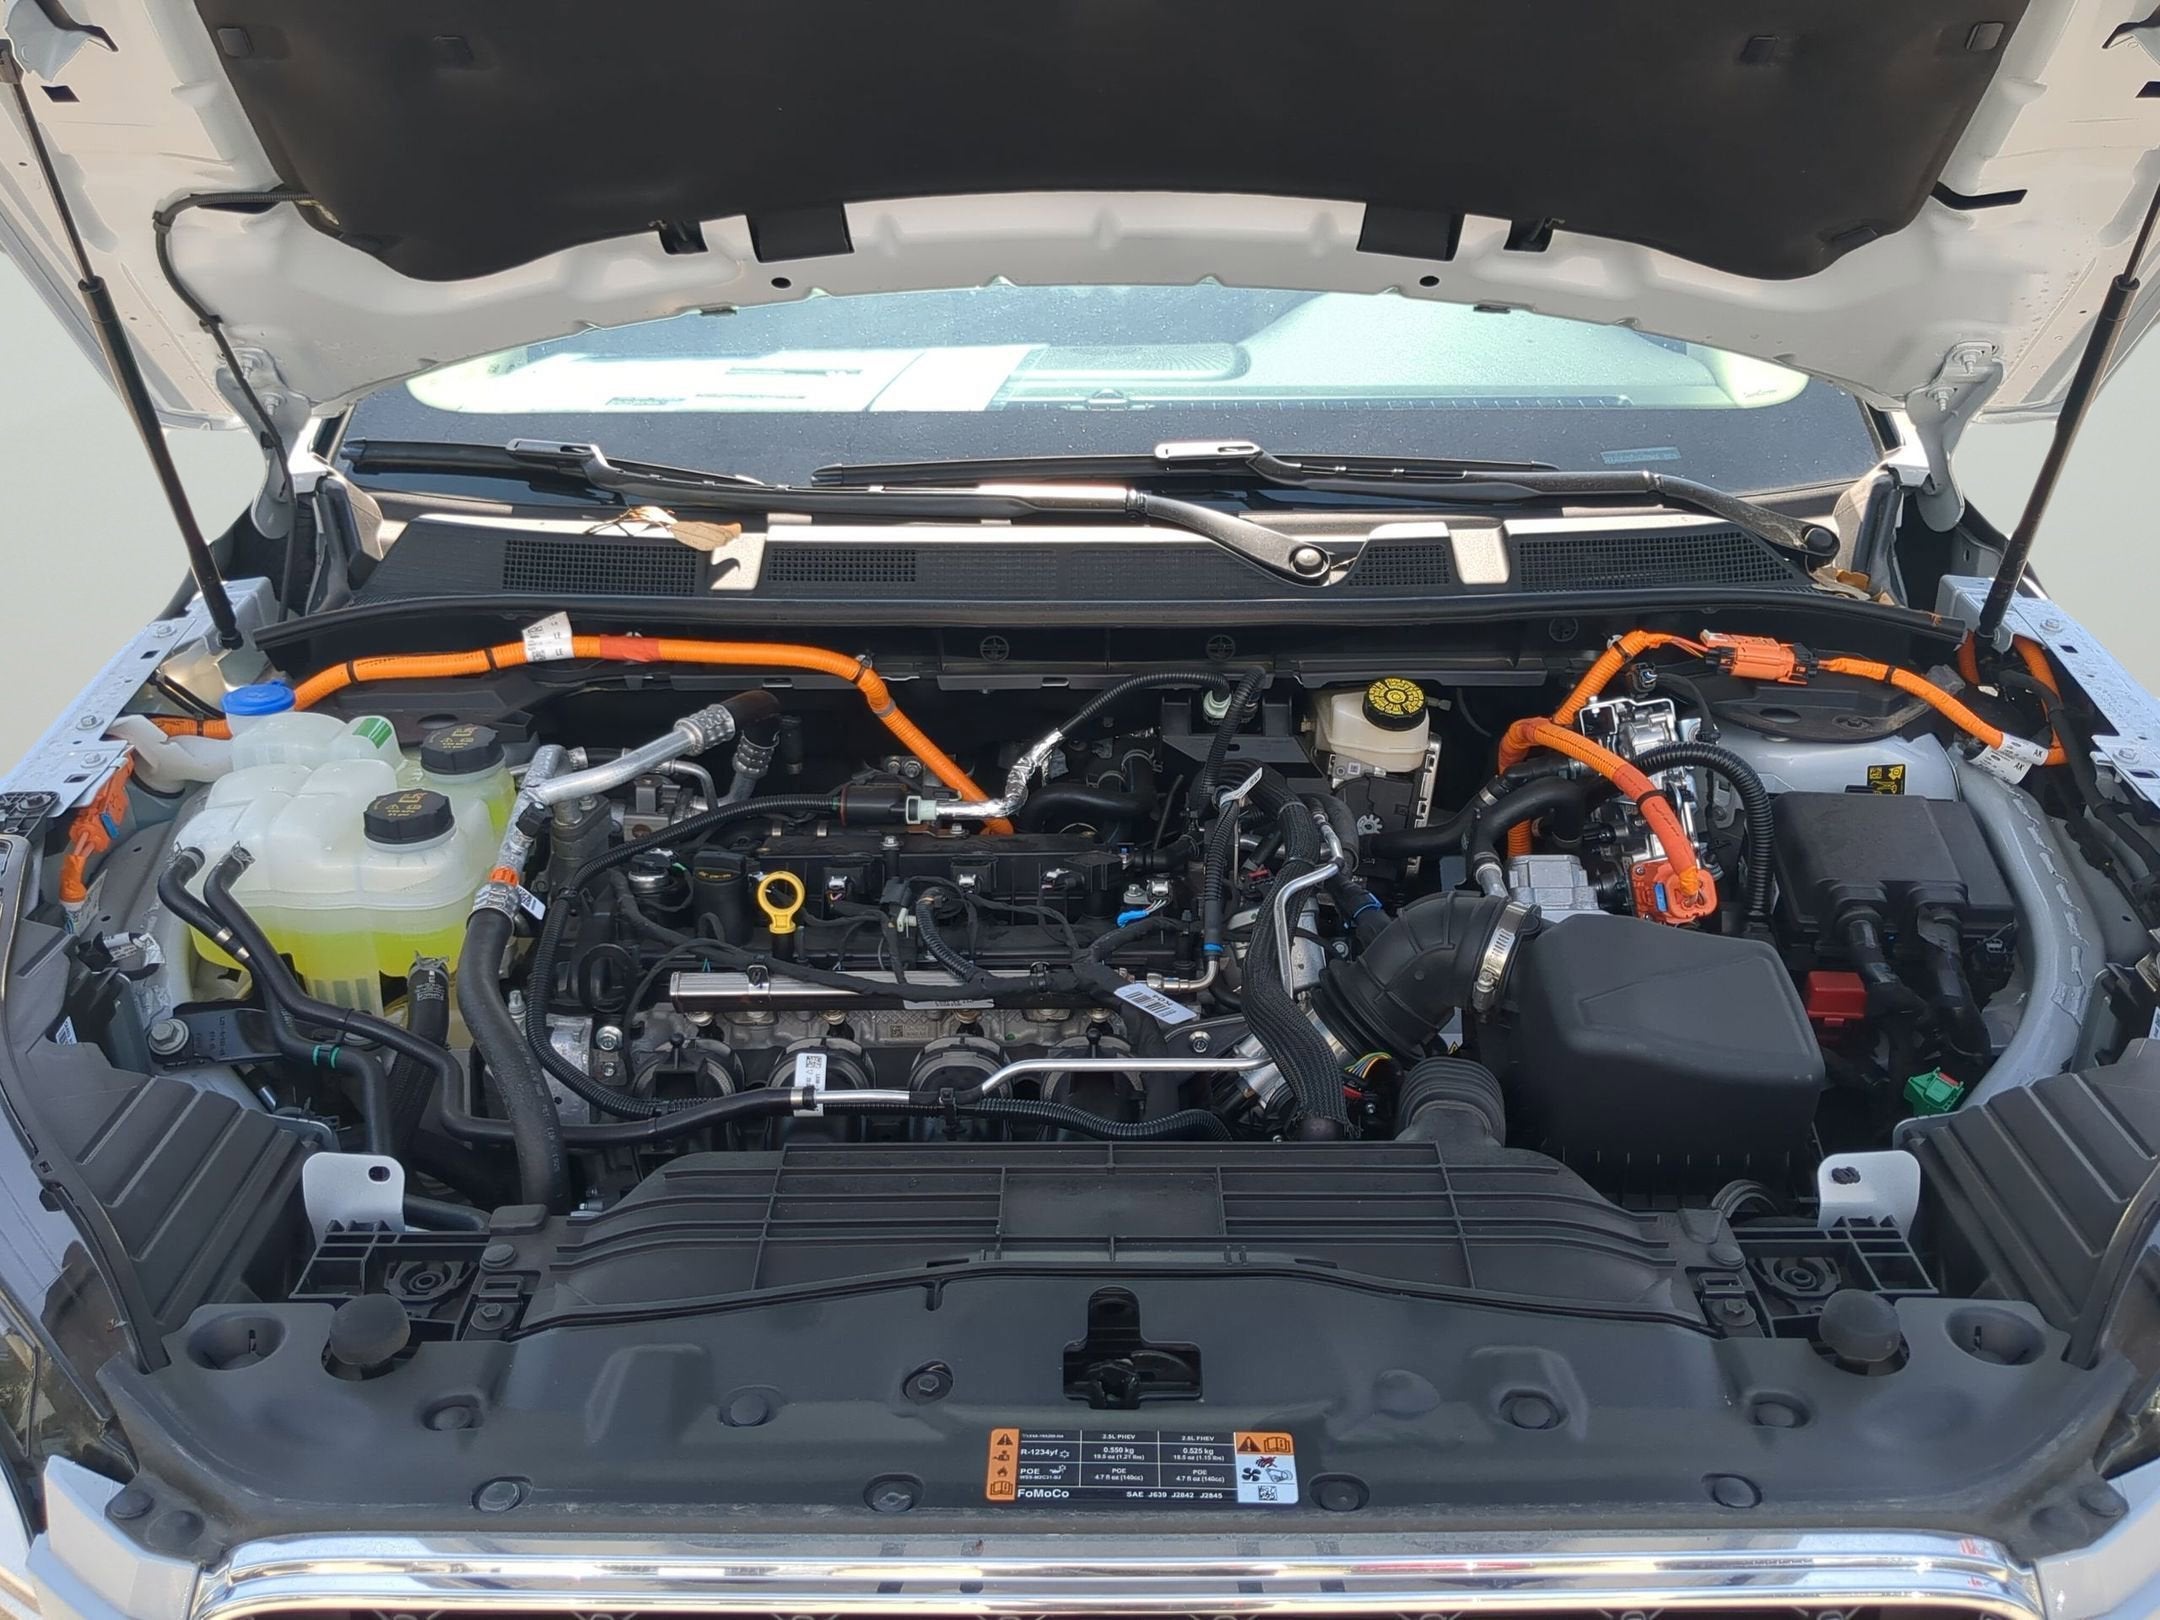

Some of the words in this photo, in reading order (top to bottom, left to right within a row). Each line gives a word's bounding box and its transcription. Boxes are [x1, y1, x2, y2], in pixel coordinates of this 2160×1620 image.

[1020, 1448, 1059, 1457] R-1234yf
[1103, 1446, 1123, 1454] 0.550
[1124, 1447, 1135, 1455] kg
[1182, 1447, 1203, 1455] 0.525
[1204, 1448, 1215, 1456] kg
[1120, 1474, 1144, 1482] (140cc)
[1201, 1475, 1225, 1483] (140cc)
[1017, 1488, 1070, 1498] FoMoCo
[1171, 1491, 1195, 1499] J2842
